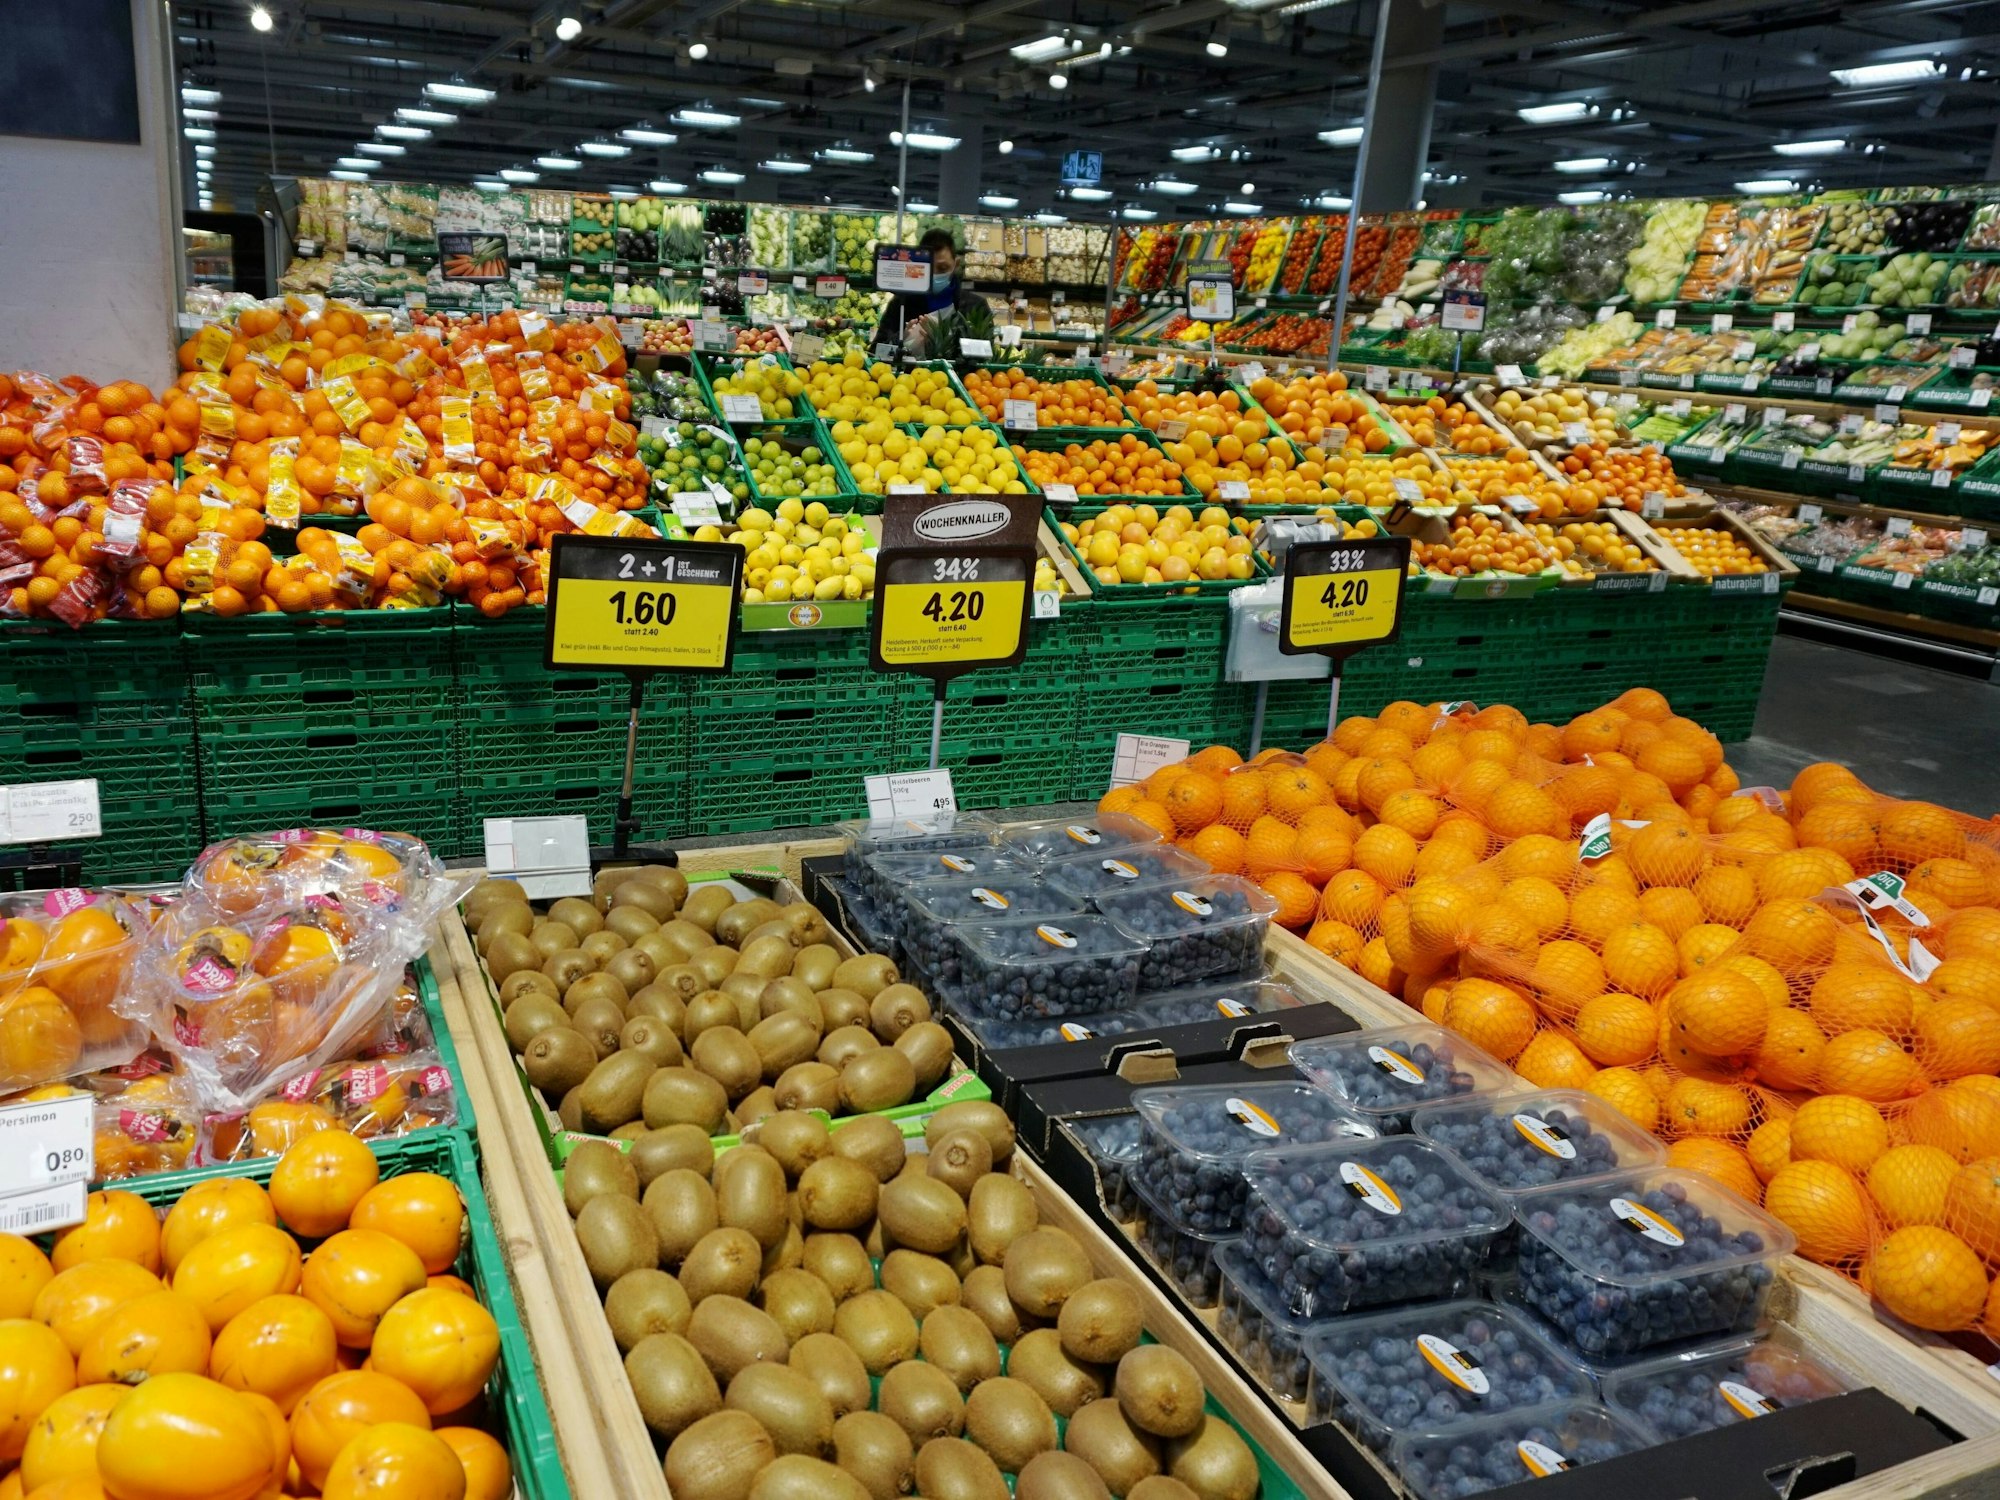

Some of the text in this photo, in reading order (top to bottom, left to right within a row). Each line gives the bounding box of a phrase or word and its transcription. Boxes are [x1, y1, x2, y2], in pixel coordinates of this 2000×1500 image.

[1643, 372, 1680, 384] naturaplan
[1771, 377, 1815, 390] naturaplan
[1839, 384, 1887, 397] naturaplan
[1917, 390, 1969, 402] naturaplan
[1671, 444, 1711, 457] naturaplan
[1739, 448, 1782, 463] naturaplan
[1803, 461, 1848, 476] naturaplan
[1880, 467, 1931, 482] naturaplan
[920, 511, 1005, 531] WOCHENKNALLER
[618, 553, 676, 581] 2 + 1
[677, 560, 690, 570] IST
[1329, 549, 1366, 572] 33%
[677, 568, 720, 579] GESCHENKT
[932, 557, 980, 582] 34%
[1845, 564, 1894, 582] naturaplan
[1596, 577, 1649, 591] naturaplan
[1715, 577, 1763, 592] naturaplan
[1924, 580, 1978, 597] naturaplan
[1320, 578, 1369, 609] 4.20
[609, 590, 677, 627] 1.60
[921, 590, 985, 623] 4.20
[624, 628, 659, 637] statt 2.40
[953, 624, 967, 632] 6.40
[573, 644, 586, 652] grün
[885, 646, 906, 654] Packung
[891, 777, 931, 785] Heidelbeeren
[1588, 841, 1608, 854] bio
[1877, 873, 1897, 890] bio
